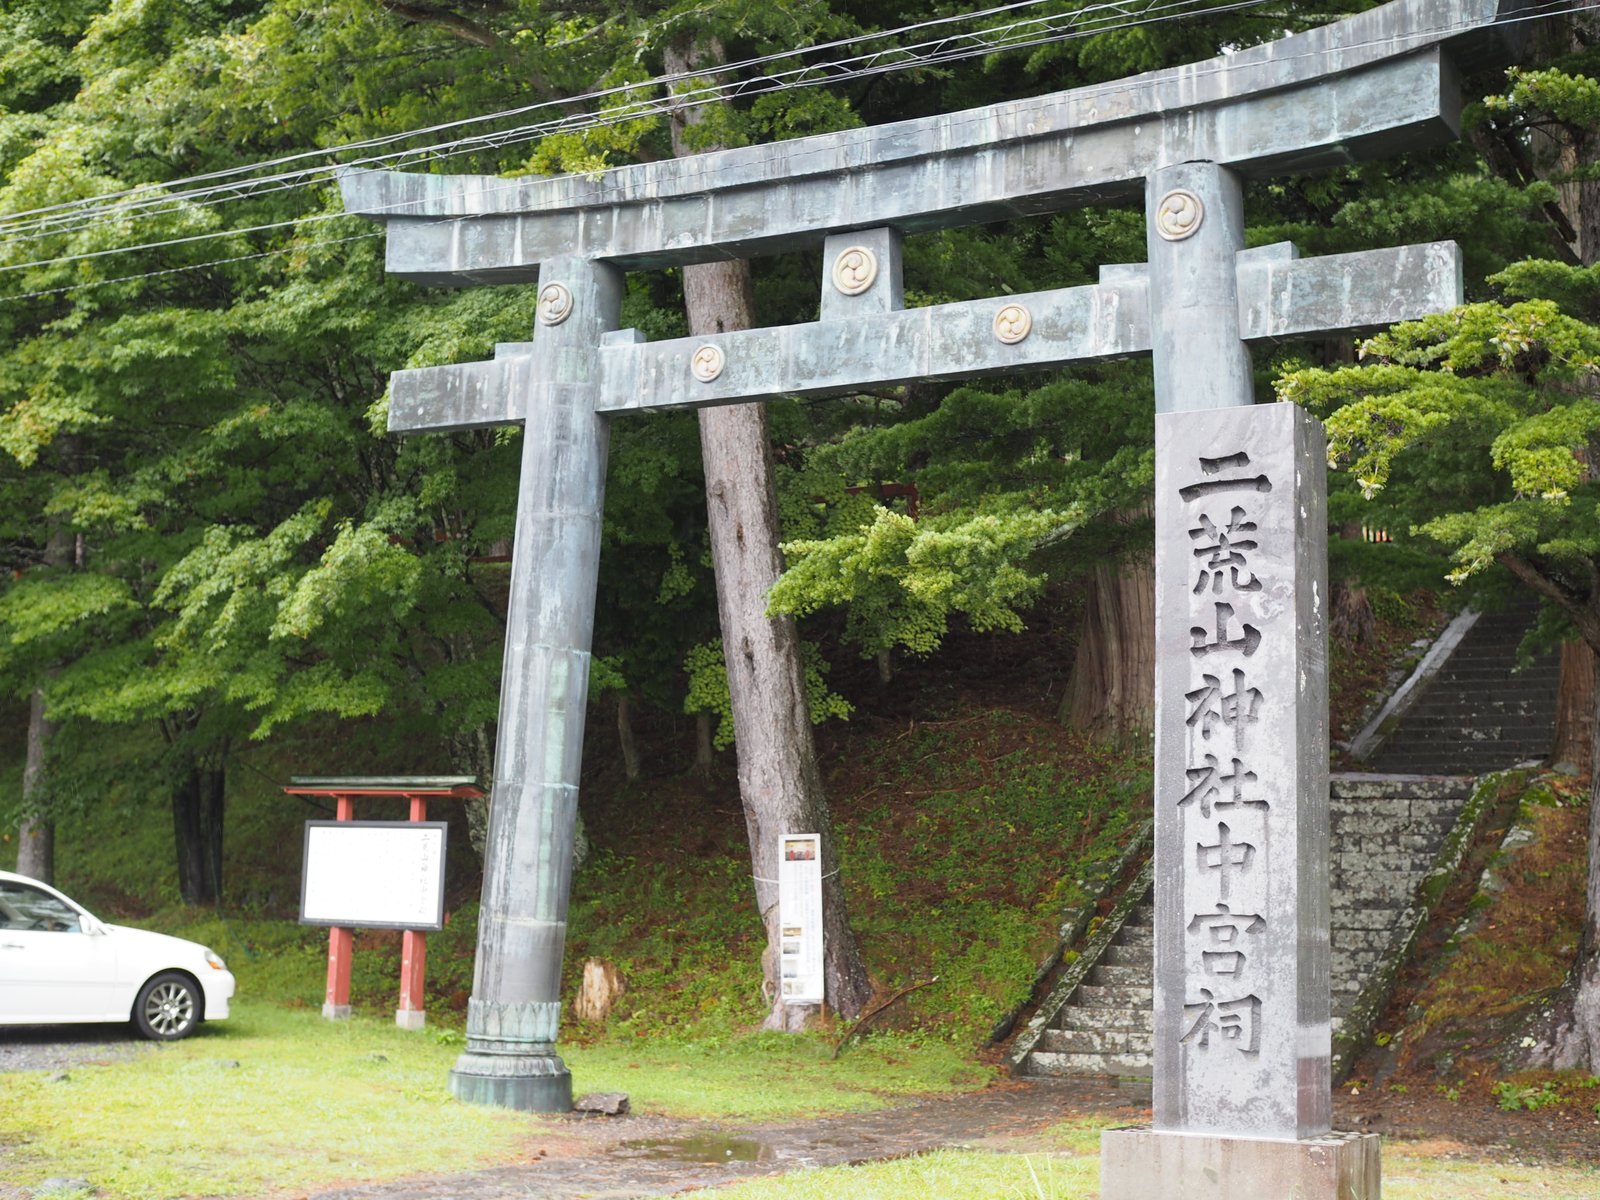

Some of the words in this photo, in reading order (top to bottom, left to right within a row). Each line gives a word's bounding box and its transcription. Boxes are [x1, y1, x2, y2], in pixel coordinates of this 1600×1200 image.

[1177, 451, 1272, 1057] 二荒山神社中宮祠
